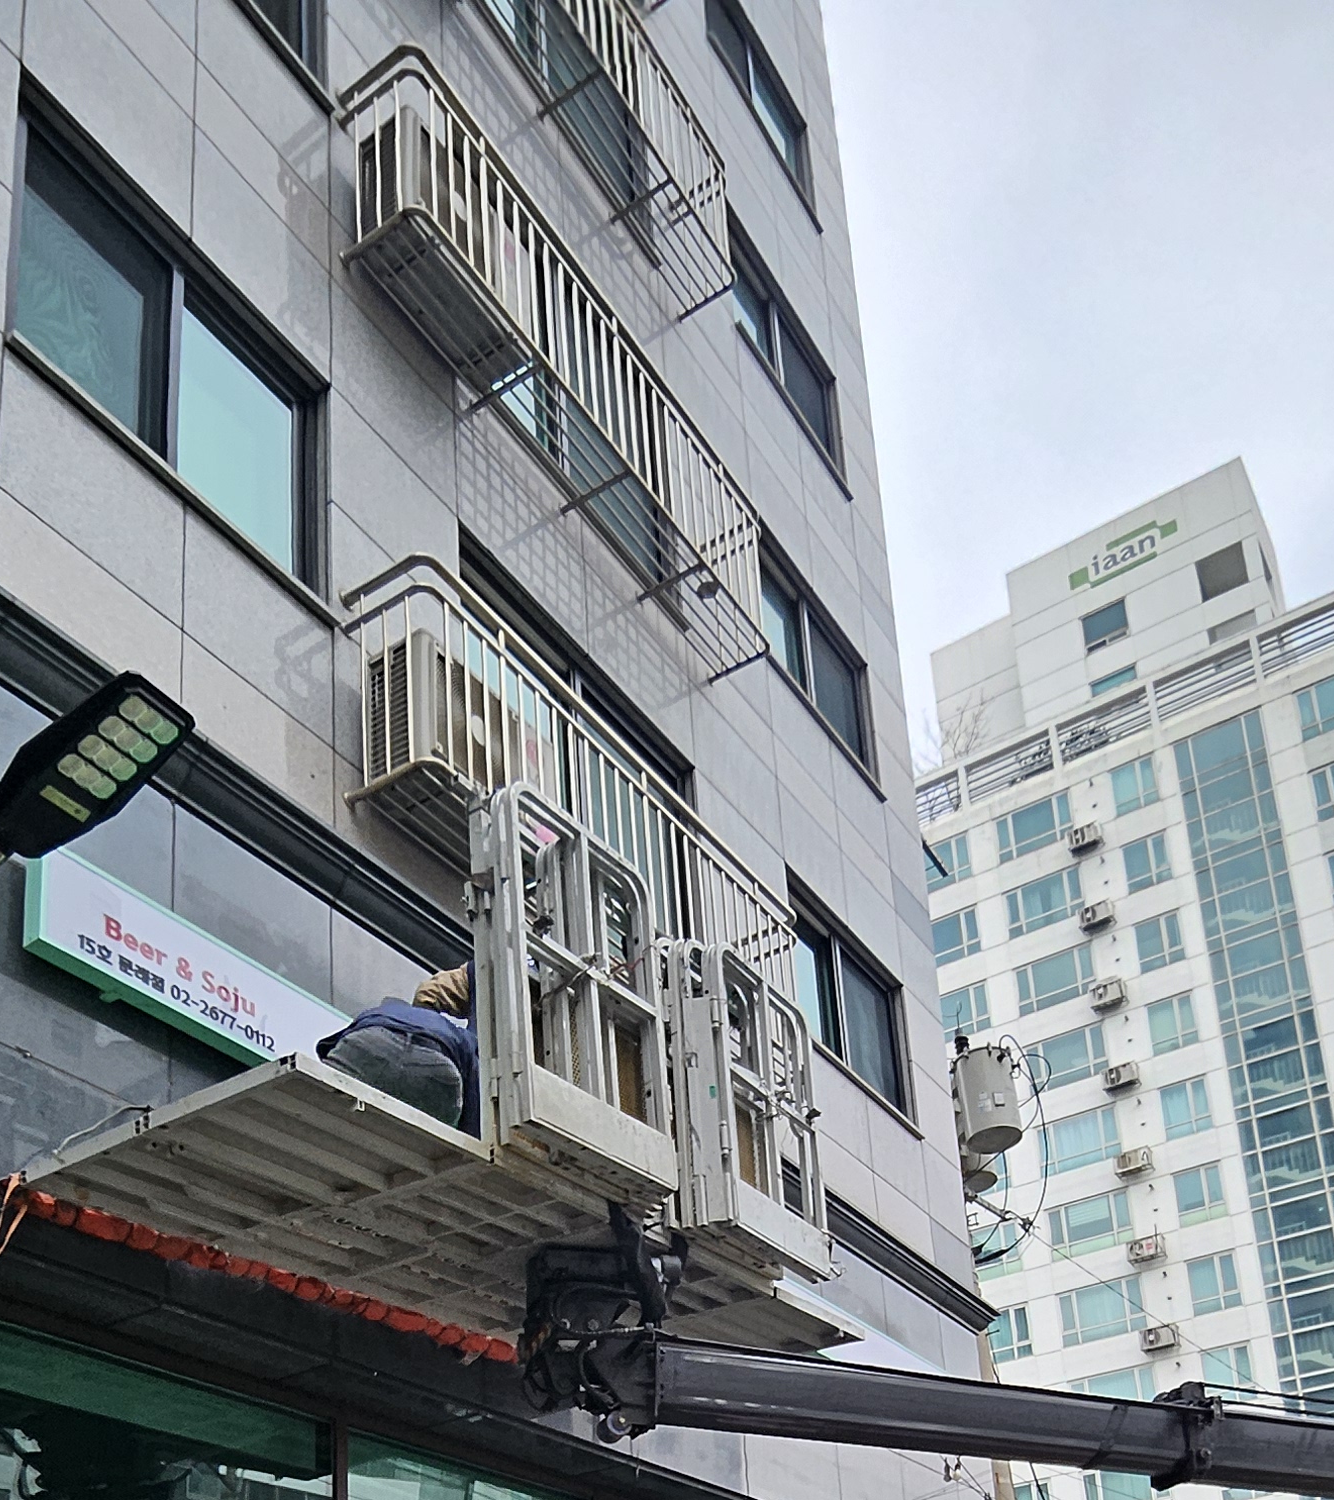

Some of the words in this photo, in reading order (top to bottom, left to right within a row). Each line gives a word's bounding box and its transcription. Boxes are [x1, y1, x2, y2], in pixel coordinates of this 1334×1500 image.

[1091, 535, 1156, 576] iaan
[78, 934, 113, 966] 15호
[170, 984, 276, 1051] 02-2677-0112
[103, 914, 168, 965] Beer
[176, 957, 194, 982] &
[202, 970, 256, 1017] Soju
